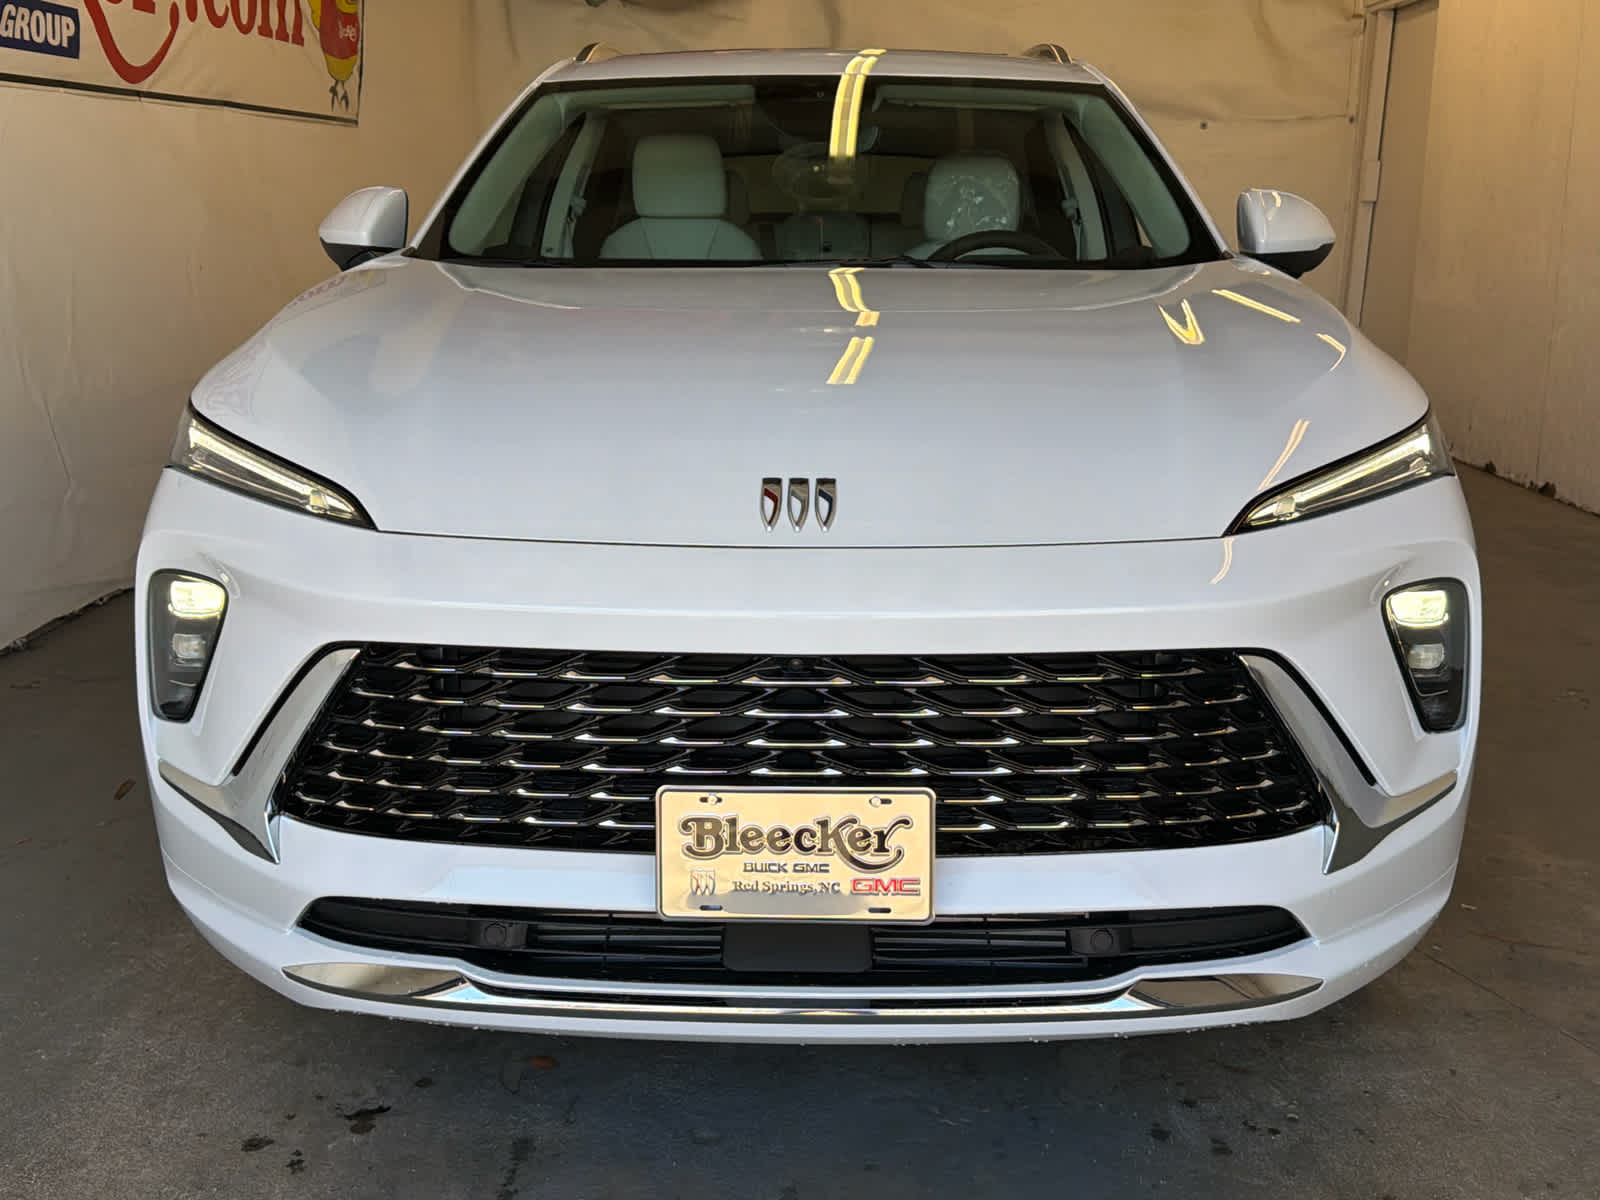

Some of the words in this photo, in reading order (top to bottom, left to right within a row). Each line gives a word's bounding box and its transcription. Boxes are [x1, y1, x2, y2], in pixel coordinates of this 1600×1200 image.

[0, 4, 76, 48] GROUP
[743, 862, 788, 873] BUICK
[792, 863, 830, 873] GMC
[733, 880, 759, 892] Red
[850, 878, 921, 896] GMC
